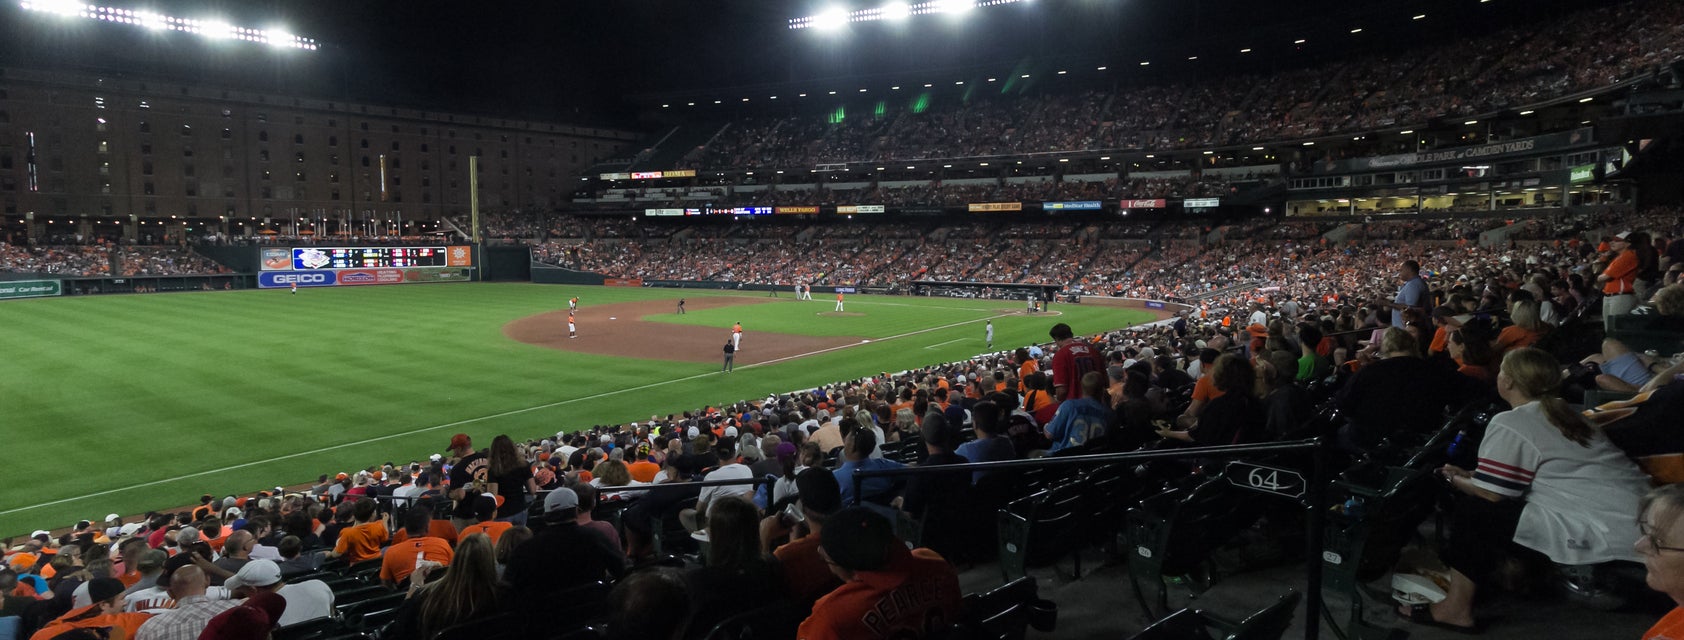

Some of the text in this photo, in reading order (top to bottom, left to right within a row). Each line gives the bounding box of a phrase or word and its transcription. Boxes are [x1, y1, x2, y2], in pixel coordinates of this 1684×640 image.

[1400, 152, 1432, 165] ORIOLE
[1433, 151, 1456, 161] PARK
[1465, 144, 1504, 157] CAMDEN
[1505, 140, 1534, 153] YARDS
[273, 273, 326, 284] GEICO
[1249, 467, 1280, 491] 64
[861, 575, 943, 637] PEARCE
